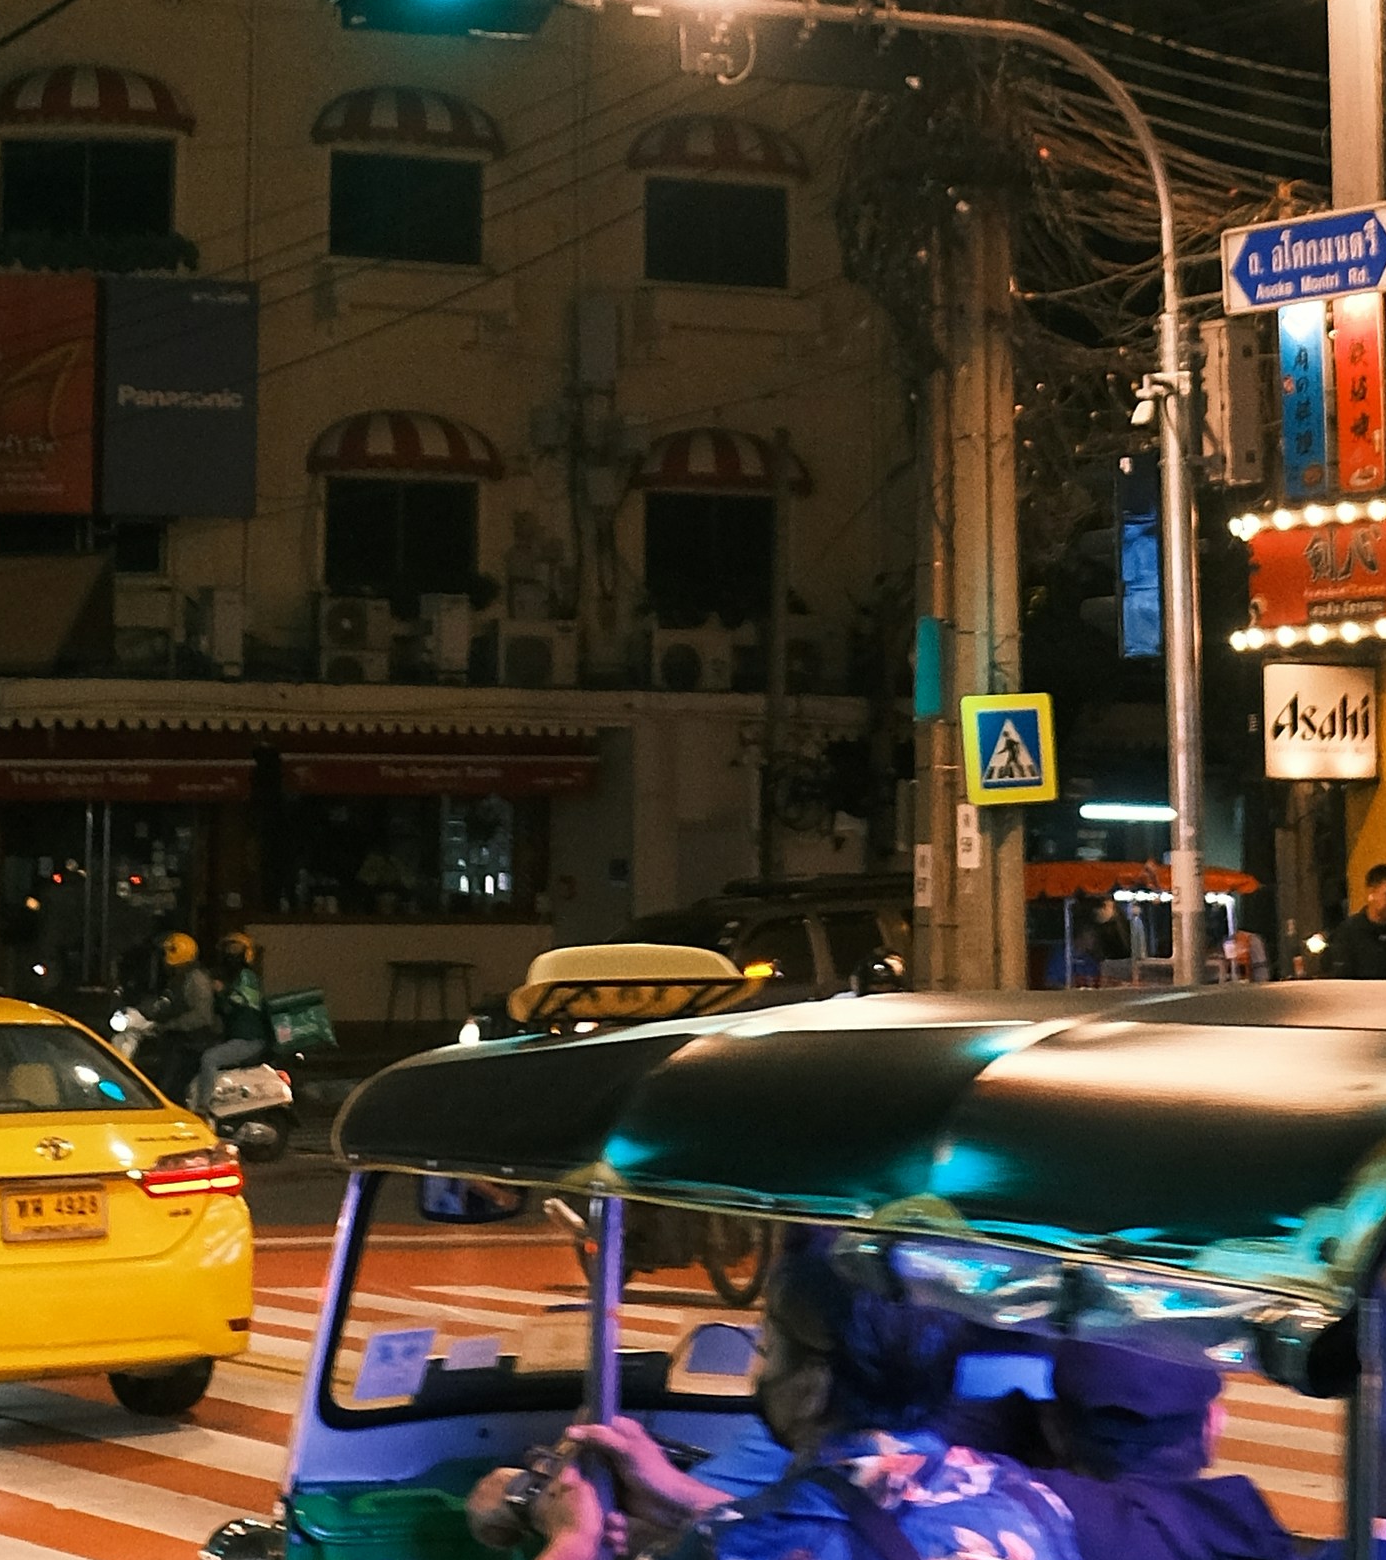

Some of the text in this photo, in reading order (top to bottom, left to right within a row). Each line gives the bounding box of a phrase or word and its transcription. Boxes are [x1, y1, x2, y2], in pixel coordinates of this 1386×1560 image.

[1271, 217, 1379, 273] อโศกมนตรี
[117, 384, 244, 408] Panasonic
[1271, 691, 1371, 742] Asahi
